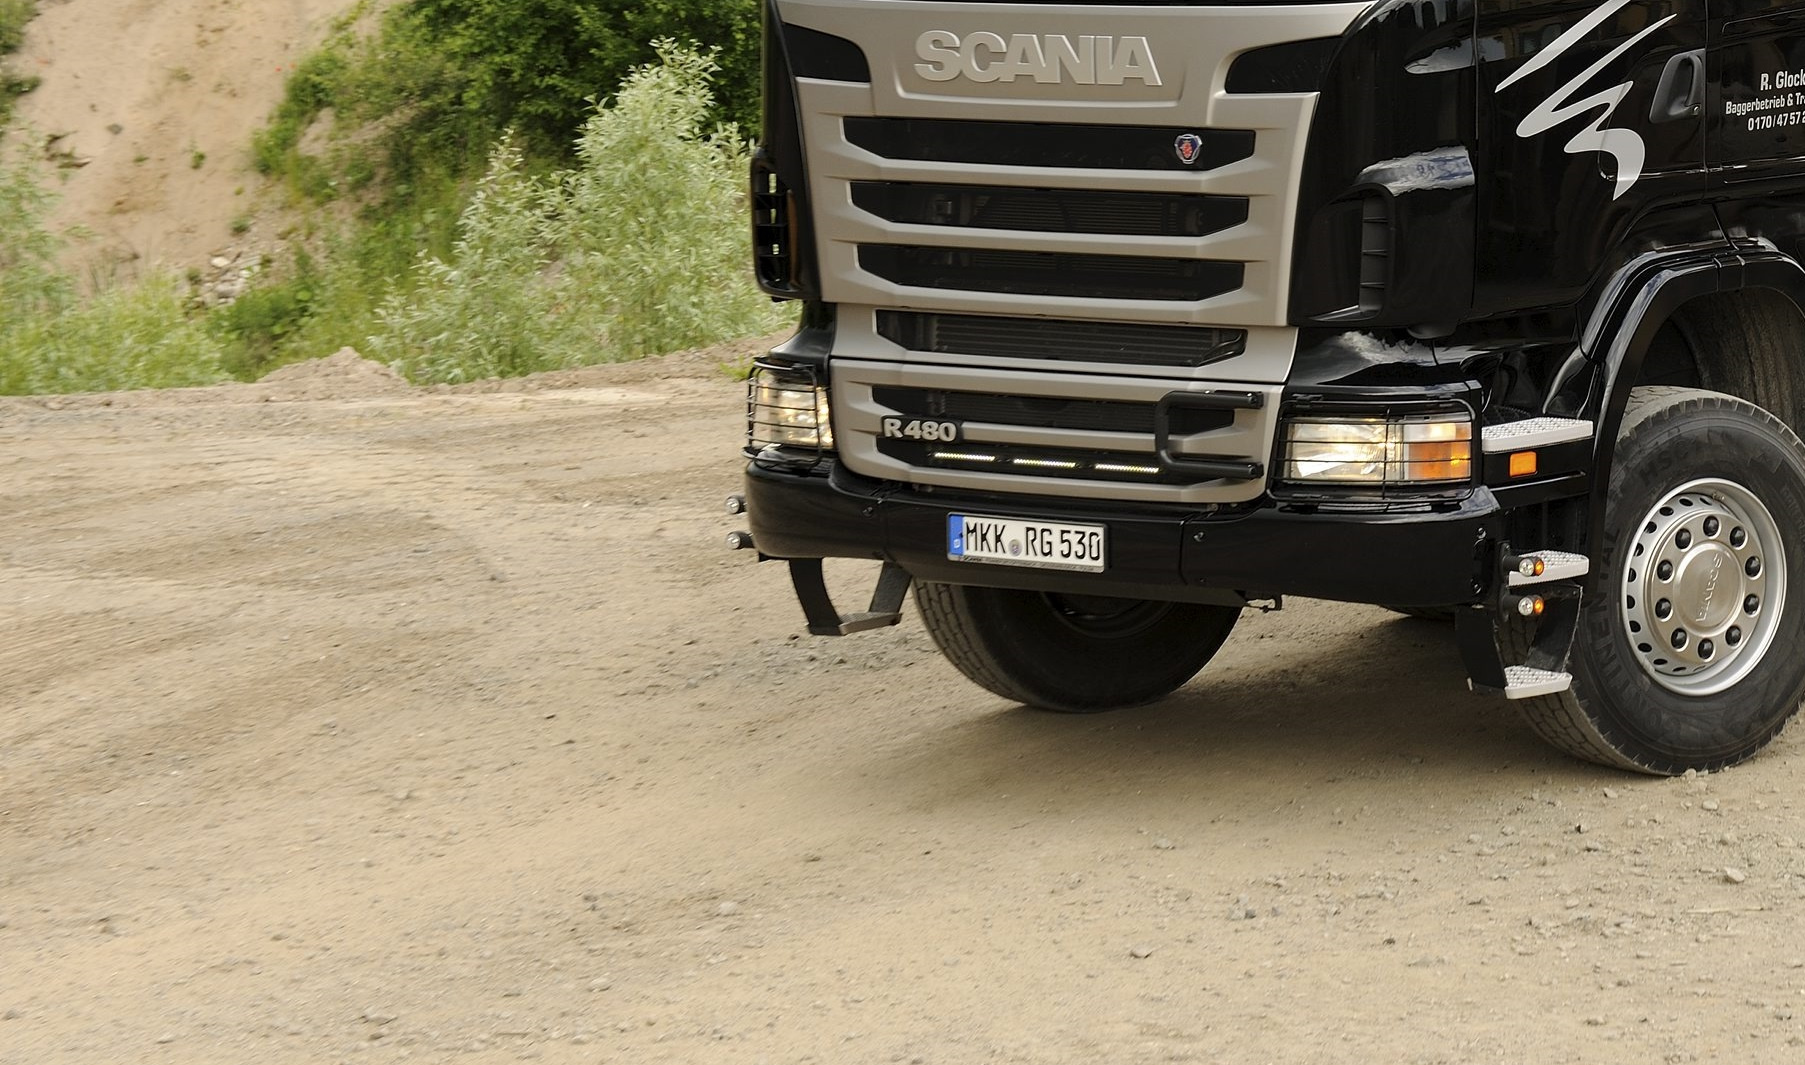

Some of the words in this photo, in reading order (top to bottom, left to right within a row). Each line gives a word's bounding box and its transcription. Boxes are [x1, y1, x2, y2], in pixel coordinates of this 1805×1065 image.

[914, 29, 1163, 86] SCANIA
[1760, 73, 1772, 91] R.
[1725, 95, 1785, 116] Baggerbetrieb
[1786, 93, 1794, 107] &
[965, 521, 1006, 554] MKK
[1025, 527, 1053, 557] RG
[1060, 529, 1101, 561] 530
